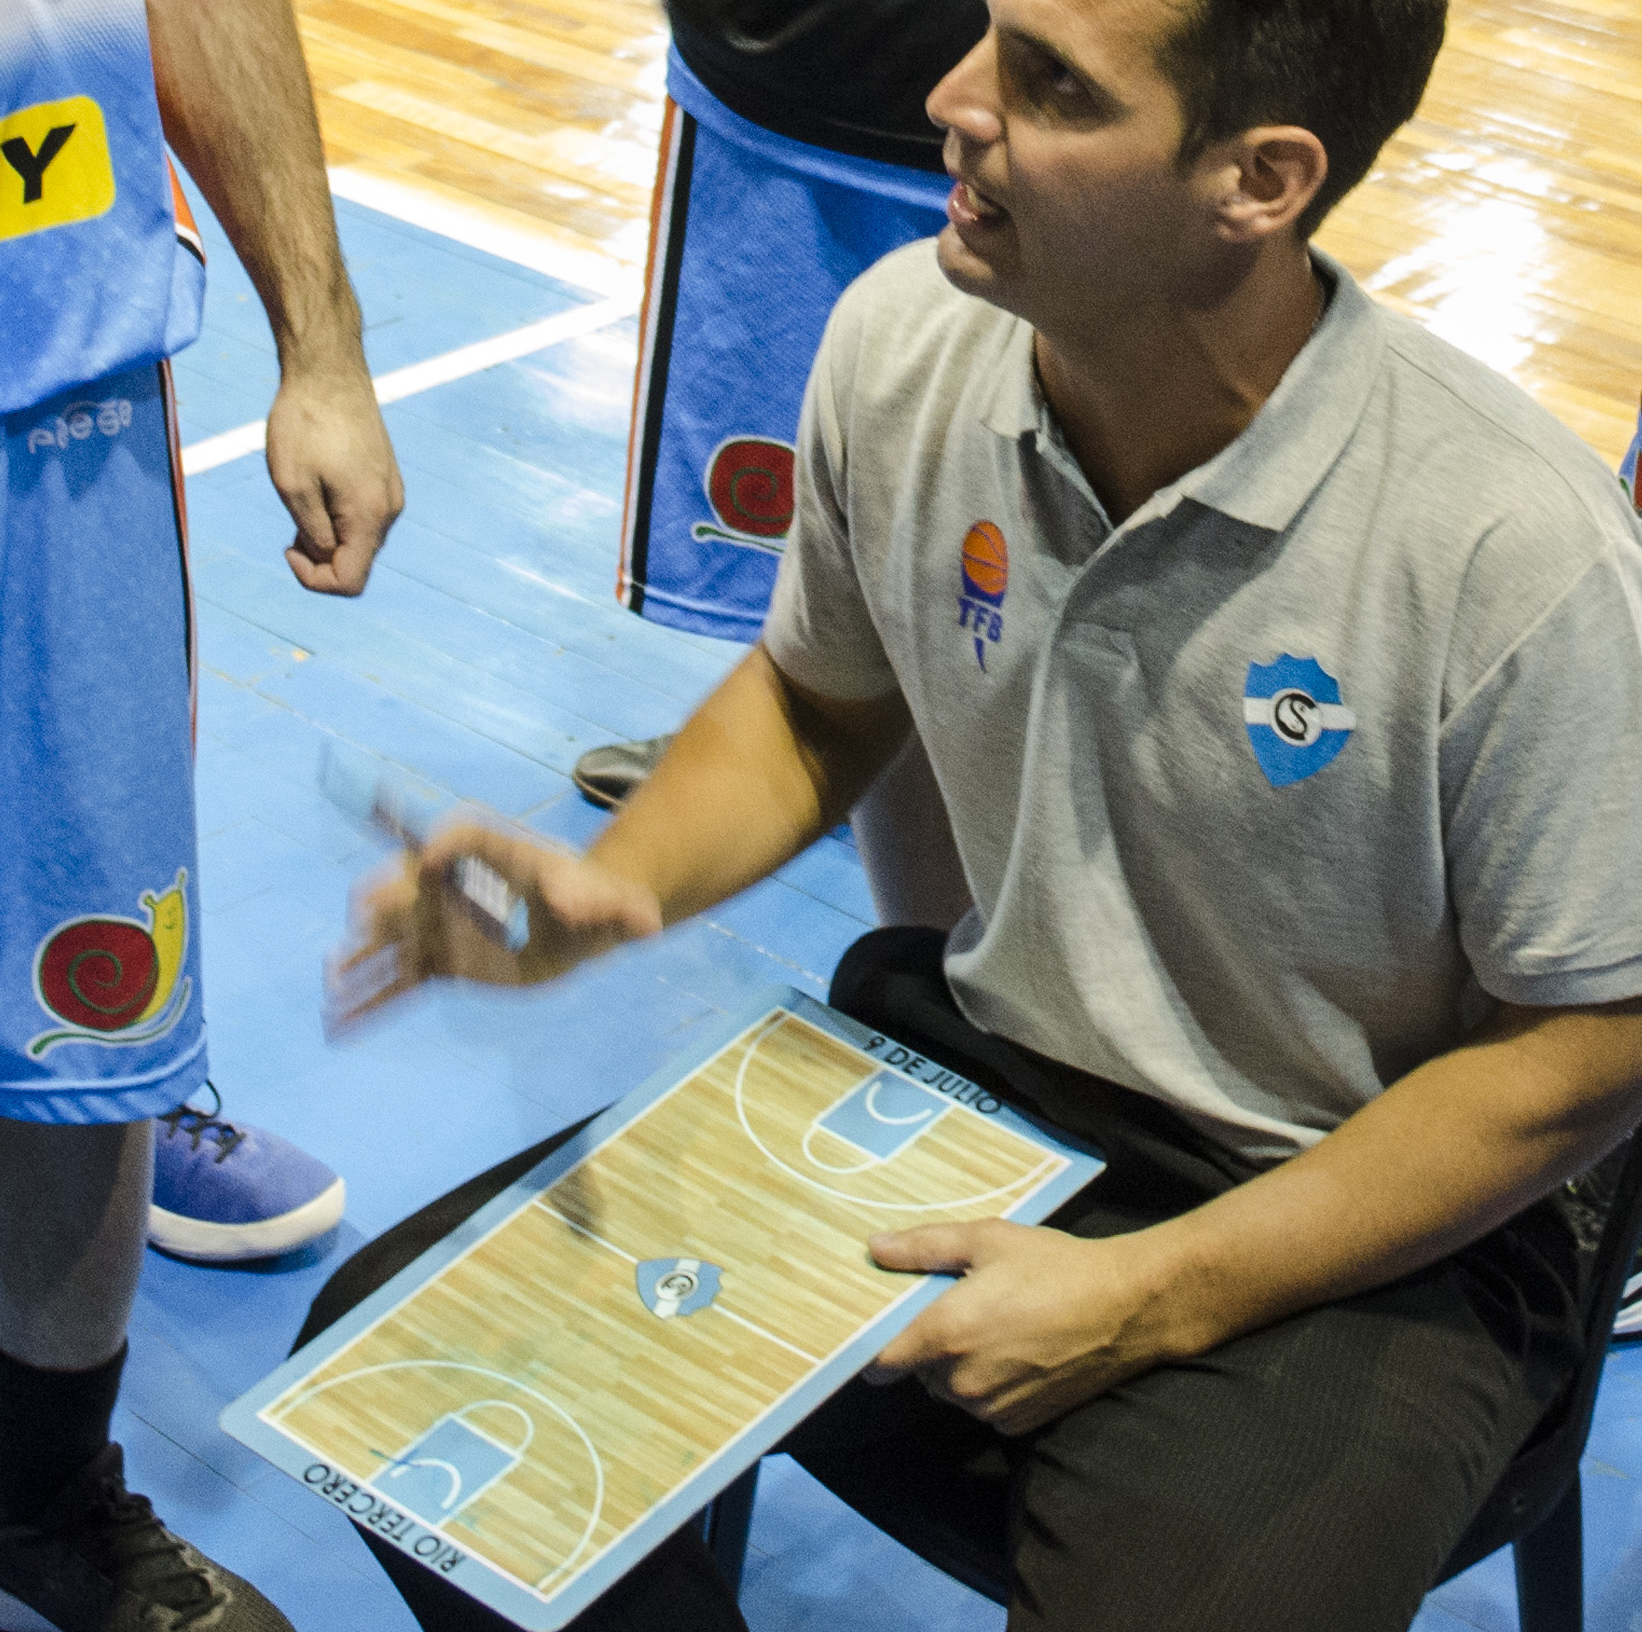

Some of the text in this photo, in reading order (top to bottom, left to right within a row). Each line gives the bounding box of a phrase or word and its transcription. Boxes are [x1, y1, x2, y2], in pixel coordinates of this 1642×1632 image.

[957, 597, 1004, 644] TFB
[863, 1035, 1003, 1114] 9 DE JULIO
[303, 1463, 467, 1573] RIO TERCERO
